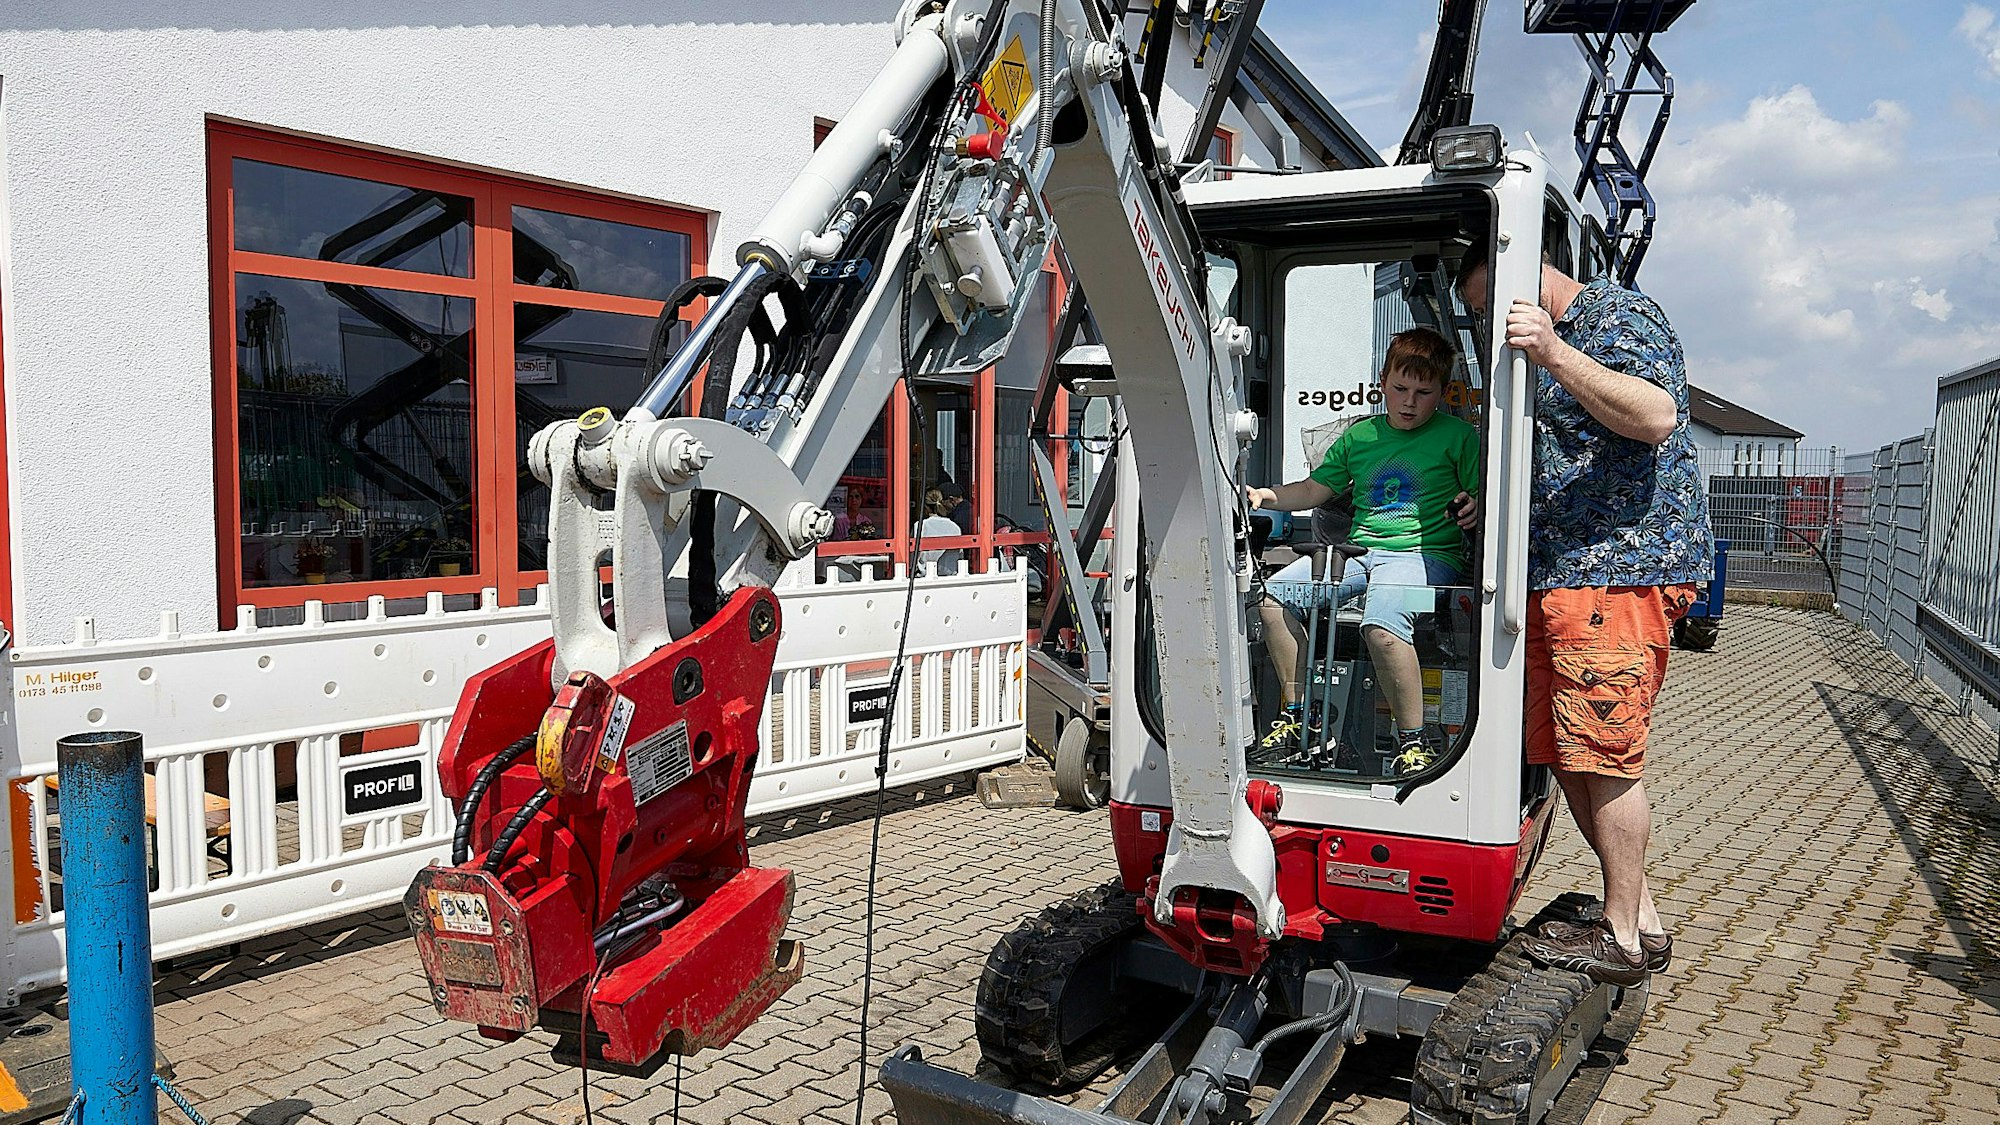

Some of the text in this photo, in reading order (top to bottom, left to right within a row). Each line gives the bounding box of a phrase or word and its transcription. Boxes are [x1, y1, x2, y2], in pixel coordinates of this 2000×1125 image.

[26, 670, 99, 686] M. Hilger
[18, 687, 46, 698] 0173
[852, 695, 888, 713] PROFIL
[353, 773, 415, 799] PROFIL
